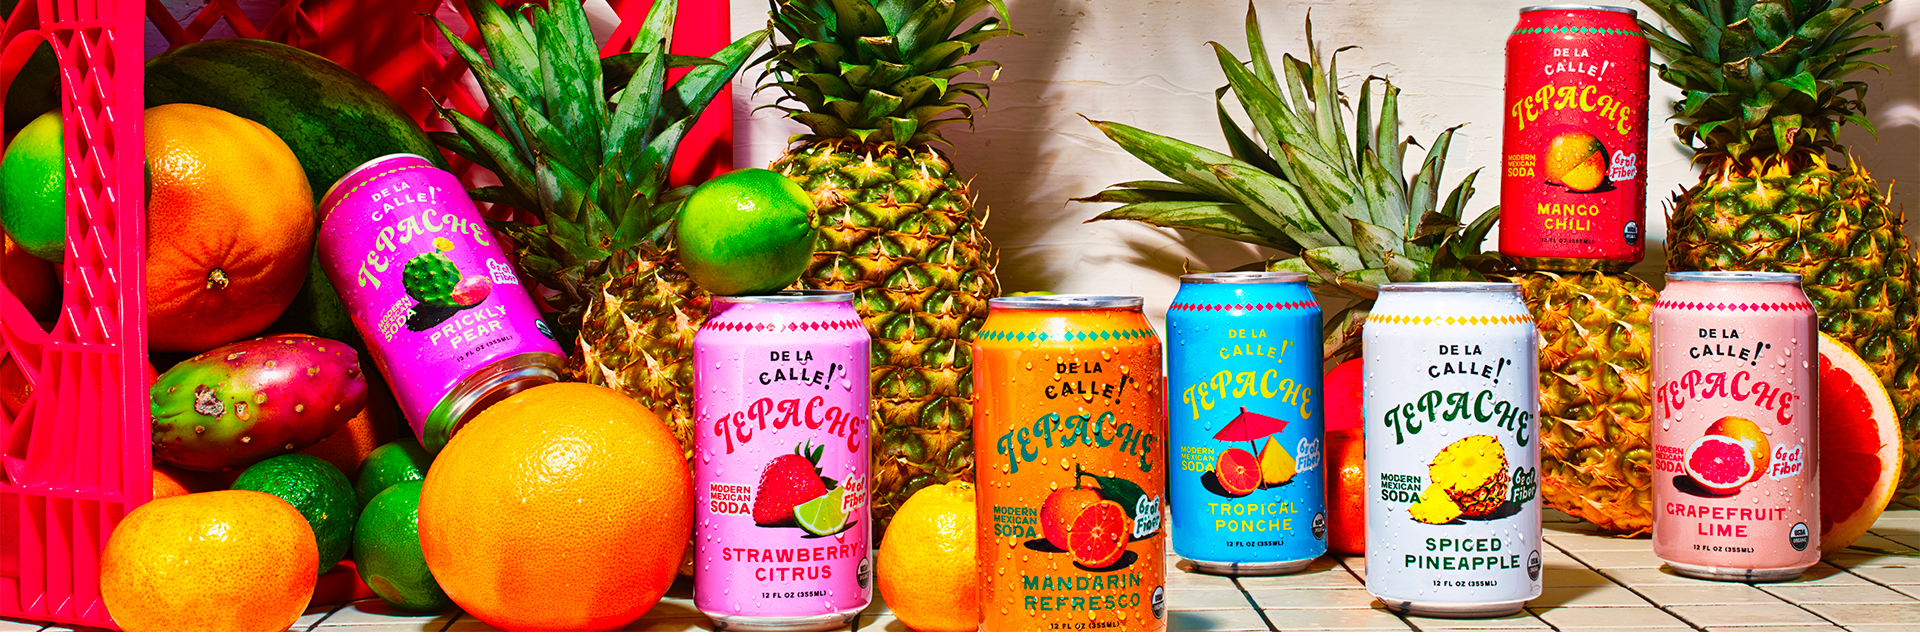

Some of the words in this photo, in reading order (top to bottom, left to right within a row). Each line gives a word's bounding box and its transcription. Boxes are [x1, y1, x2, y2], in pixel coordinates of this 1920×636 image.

[1554, 48, 1569, 56] DE
[1575, 49, 1588, 57] LA
[1544, 60, 1609, 81] CALLE!
[1512, 84, 1631, 134] TEPACHE
[1508, 168, 1535, 177] SODA
[1612, 167, 1635, 178] Fiber
[371, 188, 391, 202] DE
[393, 181, 410, 192] LA
[371, 186, 436, 221] CALLE!
[1538, 204, 1599, 216] MANGO
[1544, 218, 1590, 230] CHILI
[358, 209, 489, 290] TEPACHE
[378, 295, 409, 329] MODERN
[381, 301, 412, 335] MEXICAN
[385, 308, 417, 342] SODA
[430, 305, 506, 346] PRICKLY
[450, 320, 502, 349] PEAR
[1229, 329, 1246, 338] DE
[1252, 329, 1267, 338] LA
[1699, 329, 1717, 338] DE
[1723, 329, 1739, 339] LA
[770, 351, 790, 361] DE
[796, 351, 813, 361] LA
[1220, 340, 1288, 363] CALLE!
[1439, 345, 1459, 355] DE
[1465, 345, 1482, 355] LA
[1690, 342, 1763, 366] CALLE!
[1057, 363, 1078, 374] DE
[1085, 362, 1102, 373] LA
[1428, 357, 1505, 384] CALLE!
[759, 363, 836, 390] CALLE!
[1045, 375, 1127, 404] CALLE!
[1183, 369, 1312, 420] TEPACHE
[1657, 370, 1793, 425] TEPACHE
[714, 396, 860, 454] TEPACHE
[1384, 390, 1530, 447] TEPACHE
[997, 411, 1153, 474] TEPACHE
[1310, 442, 1317, 453] of
[1181, 446, 1214, 454] MODERN
[1181, 453, 1214, 461] MEXICAN
[1656, 445, 1684, 455] MODERN
[1656, 452, 1684, 462] MEXICAN
[1775, 447, 1786, 460] 6g
[1789, 449, 1799, 461] of
[1181, 460, 1215, 473] SODA
[1297, 455, 1319, 470] Fiber
[1656, 461, 1684, 473] SODA
[1772, 461, 1801, 476] Fiber
[857, 478, 864, 490] of
[1381, 473, 1421, 483] MODERN
[1526, 470, 1535, 484] of
[710, 484, 751, 493] MODERN
[1381, 481, 1421, 491] MEXICAN
[710, 493, 751, 502] MEXICAN
[1381, 489, 1421, 504] SODA
[1513, 485, 1536, 502] Fiber
[710, 501, 750, 514] SODA
[843, 492, 866, 510] Fiber
[994, 506, 1037, 516] MODERN
[1208, 502, 1298, 515] TROPICAL
[1667, 502, 1786, 521] GRAPEFRUIT
[994, 515, 1037, 525] MEXICAN
[1136, 515, 1160, 534] Fiber
[1216, 518, 1293, 532] PONCHE
[994, 524, 1037, 538] SODA
[1698, 523, 1747, 537] LIME
[1426, 538, 1502, 551] SPICED
[723, 543, 858, 563] STRAWBERRY
[1405, 555, 1520, 570] PINEAPPLE
[755, 565, 832, 581] CITRUS
[1023, 572, 1140, 591] MANDARIN
[797, 590, 826, 598] (355ML)
[1024, 592, 1141, 611] REFRESCO
